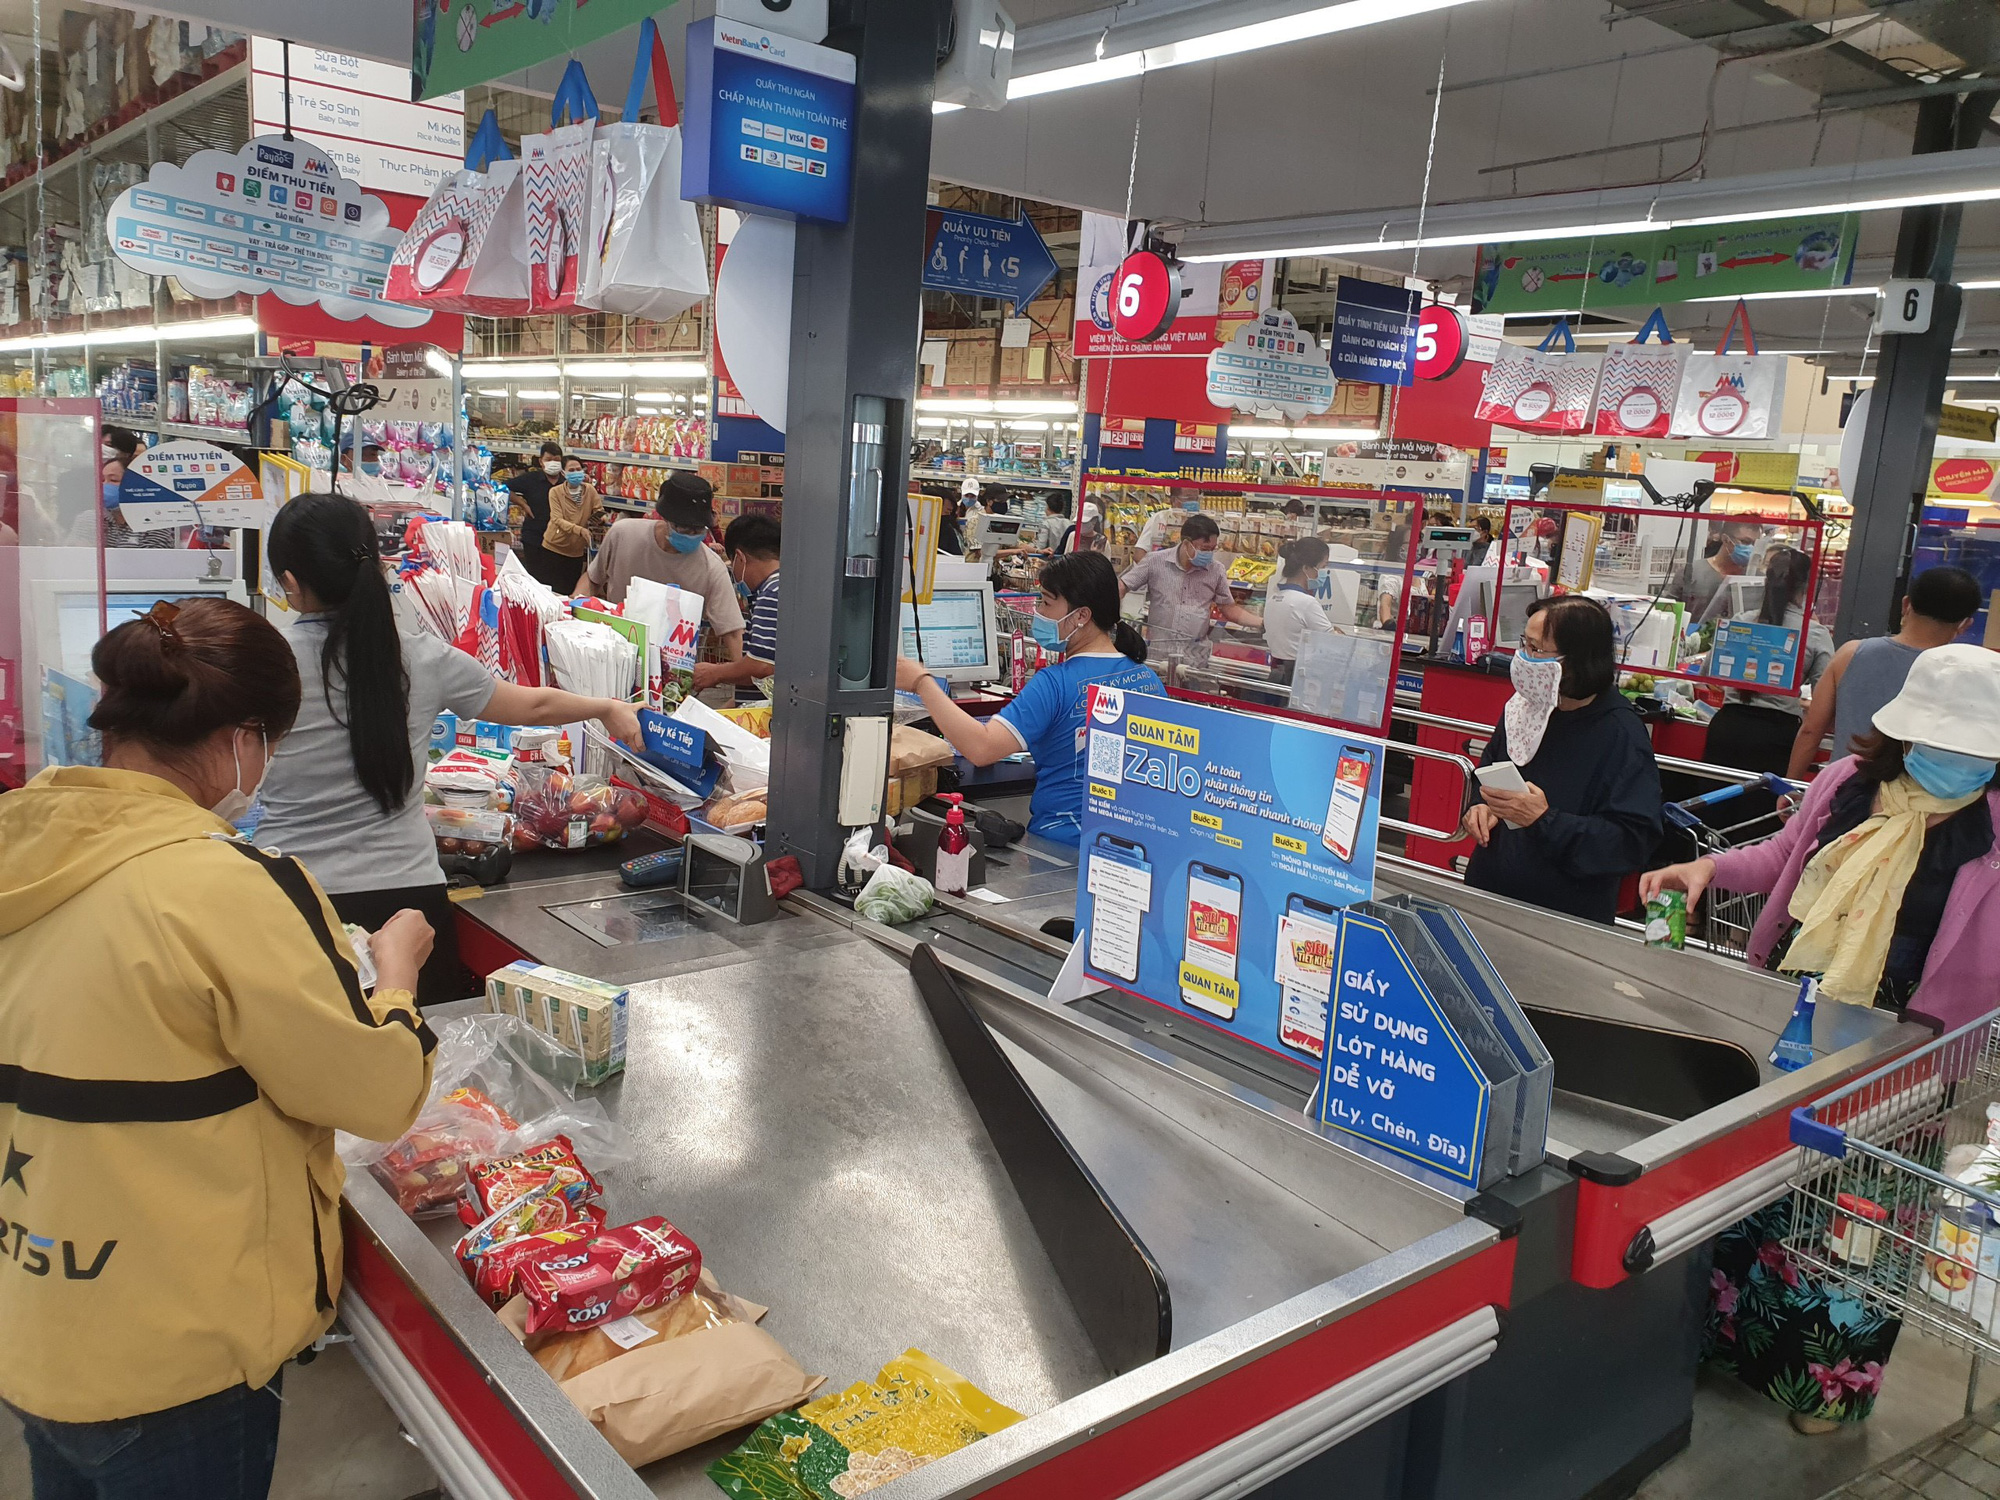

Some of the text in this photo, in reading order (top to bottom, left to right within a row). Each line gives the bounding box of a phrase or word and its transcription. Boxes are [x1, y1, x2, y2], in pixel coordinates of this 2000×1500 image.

[721, 32, 785, 58] VietinBank Card
[313, 63, 359, 79] Milk Powder
[778, 84, 793, 95] THU
[794, 88, 815, 101] NGÂN
[320, 100, 335, 112] Sơ
[337, 102, 360, 117] Sinh
[719, 90, 847, 130] CHẤP NHẬN THANH TOÁN THẺ
[318, 113, 360, 128] Baby Diaper
[417, 132, 461, 147] Rice Noodles
[788, 133, 804, 143] VISA
[259, 149, 284, 164] Payoo
[347, 152, 361, 165] Bé
[342, 165, 361, 176] Baby
[379, 158, 440, 178] Thực Phẩm
[247, 166, 335, 195] ĐIỂM THU TIỀN
[943, 219, 970, 235] QUẦY
[973, 226, 988, 237] ƯU
[954, 234, 973, 244] Priority
[1119, 273, 1143, 317] 6
[1903, 288, 1920, 321] 6
[1357, 319, 1371, 330] TÍNH
[1389, 325, 1398, 334] ƯU
[1090, 331, 1206, 344] VIỆN VIỆT NAM
[1342, 334, 1399, 352] DÀNH CHO KHÁCH
[1416, 323, 1438, 361] 5
[1359, 355, 1377, 367] HÀNG
[1379, 360, 1391, 369] TẠP
[409, 367, 413, 376] of
[1113, 432, 1128, 445] 291
[1361, 441, 1380, 450] Bánh
[1382, 443, 1400, 453] Ngon
[1416, 443, 1435, 454] Ngày
[147, 452, 174, 461] ĐIỂM
[176, 453, 198, 461] THU
[1375, 452, 1391, 460] Bakery
[663, 645, 684, 656] Mega
[1122, 671, 1152, 685] MCARD
[648, 720, 694, 748] Quầy Kế Tiếp
[1129, 722, 1195, 748] QUAN TÂM
[662, 740, 670, 748] Next
[671, 743, 680, 751] Lane
[1124, 746, 1201, 798] Zalo
[1205, 761, 1241, 779] An toàn
[1091, 785, 1108, 796] Bước
[1205, 778, 1272, 804] nhận thông tin
[1088, 806, 1098, 814] MM
[1099, 808, 1113, 818] MEGA
[1114, 811, 1134, 825] MARKET
[1111, 803, 1118, 811] và
[1118, 806, 1131, 815] chọn
[1131, 808, 1144, 819] trung
[1204, 790, 1322, 835] Khuyến mãi nhanh chóng
[1193, 813, 1218, 826] Bước 2:
[1190, 827, 1205, 837] Chọn
[1205, 831, 1215, 840] nút
[1275, 836, 1302, 850] Bước 3:
[1271, 851, 1335, 877] Tìm THÔNG TIN KHUYẾN
[1318, 875, 1333, 885] chọn
[1203, 911, 1220, 923] SIÊU
[1305, 940, 1328, 957] SIÊU
[1298, 952, 1313, 964] TIẾT
[1183, 971, 1235, 1000] QUAN TÂM
[1344, 969, 1390, 997] GIẤY
[1341, 1001, 1428, 1045] SỬ DỤNG
[1337, 1033, 1435, 1082] LÓT HÀNG
[1334, 1062, 1395, 1100] DỄ VỠ
[540, 1252, 590, 1272] COSY
[567, 1300, 612, 1324] COSY
